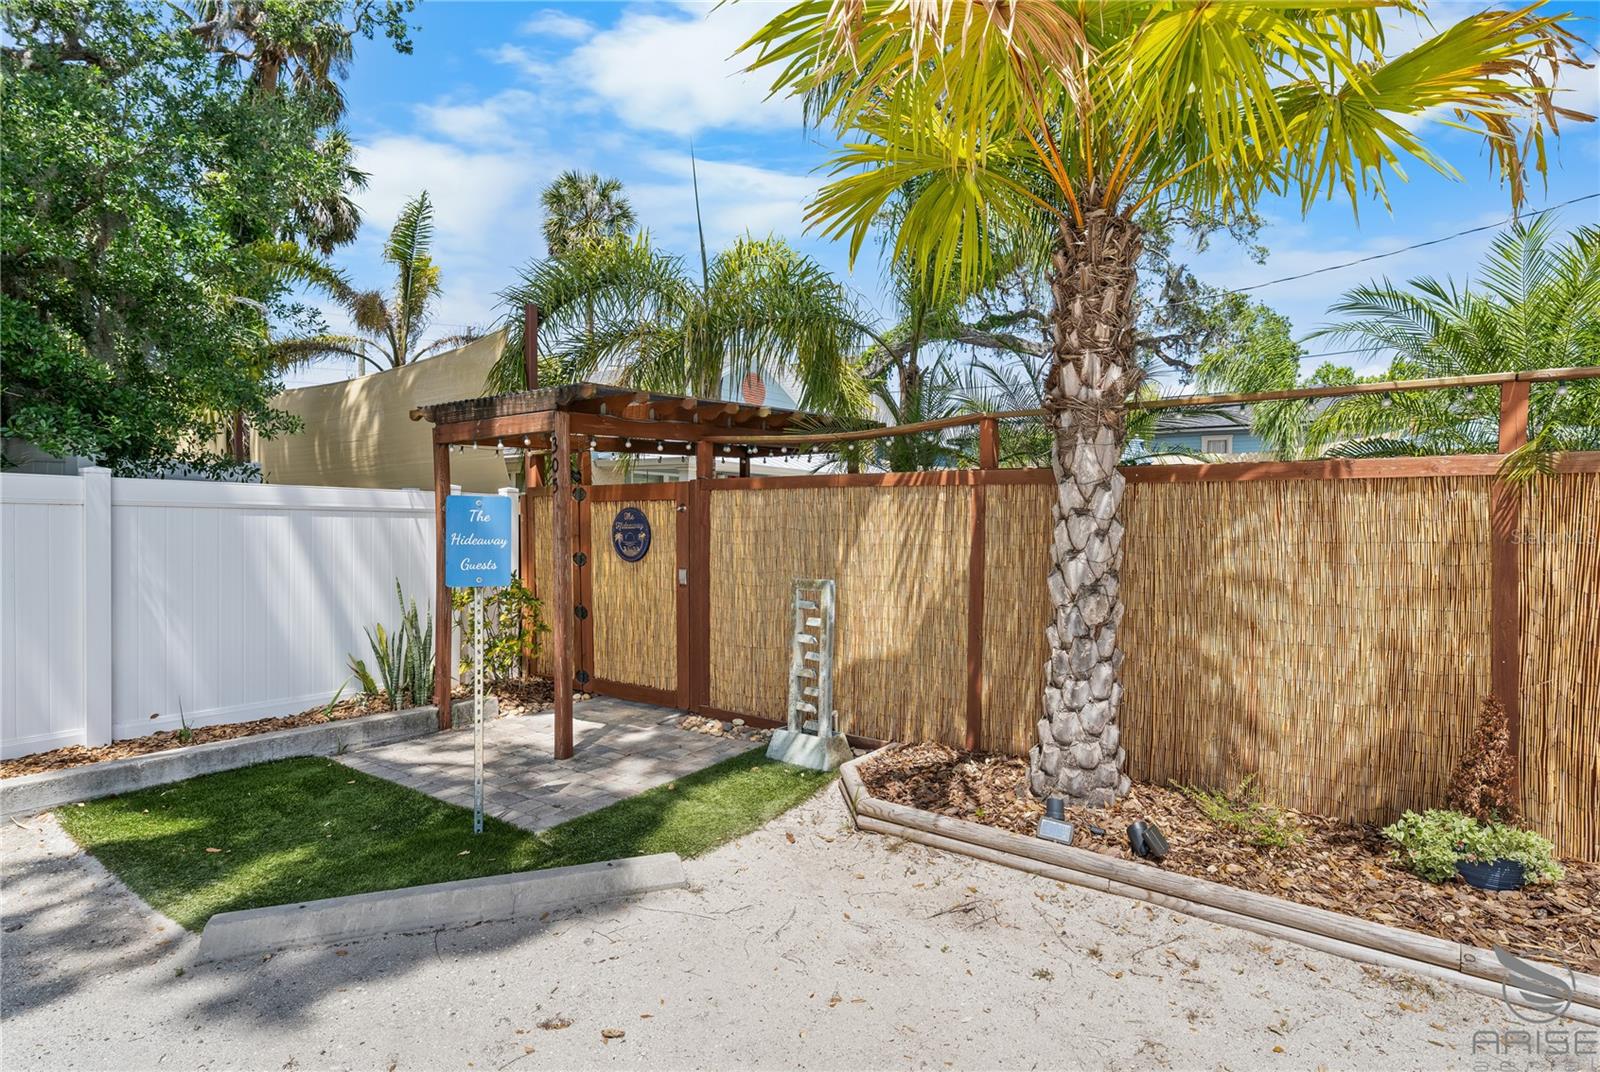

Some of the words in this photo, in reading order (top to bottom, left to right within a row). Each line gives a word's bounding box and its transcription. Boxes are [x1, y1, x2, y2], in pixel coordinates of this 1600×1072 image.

[551, 436, 560, 494] 305
[469, 509, 491, 522] The
[450, 532, 508, 548] Hideaway
[460, 557, 498, 571] Guests
